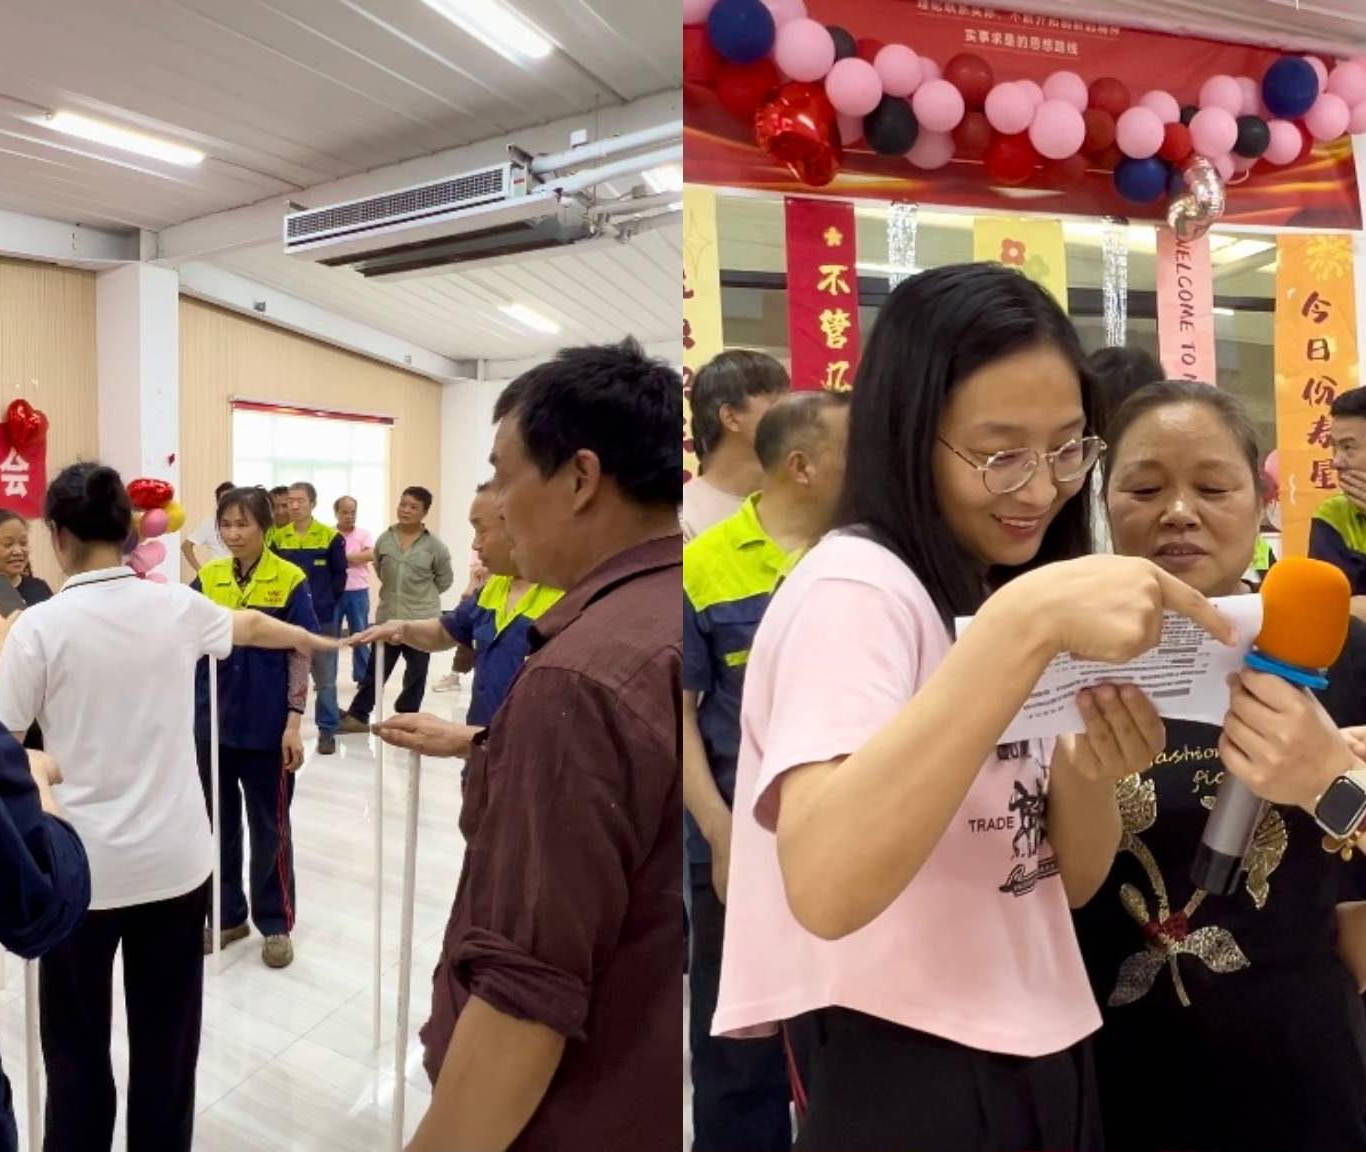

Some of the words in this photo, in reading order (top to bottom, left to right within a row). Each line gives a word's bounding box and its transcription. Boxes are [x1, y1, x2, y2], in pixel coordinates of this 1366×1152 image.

[1180, 341, 1198, 367] TO
[1301, 290, 1339, 490] 今日份寿星
[967, 816, 1015, 832] TRADE
